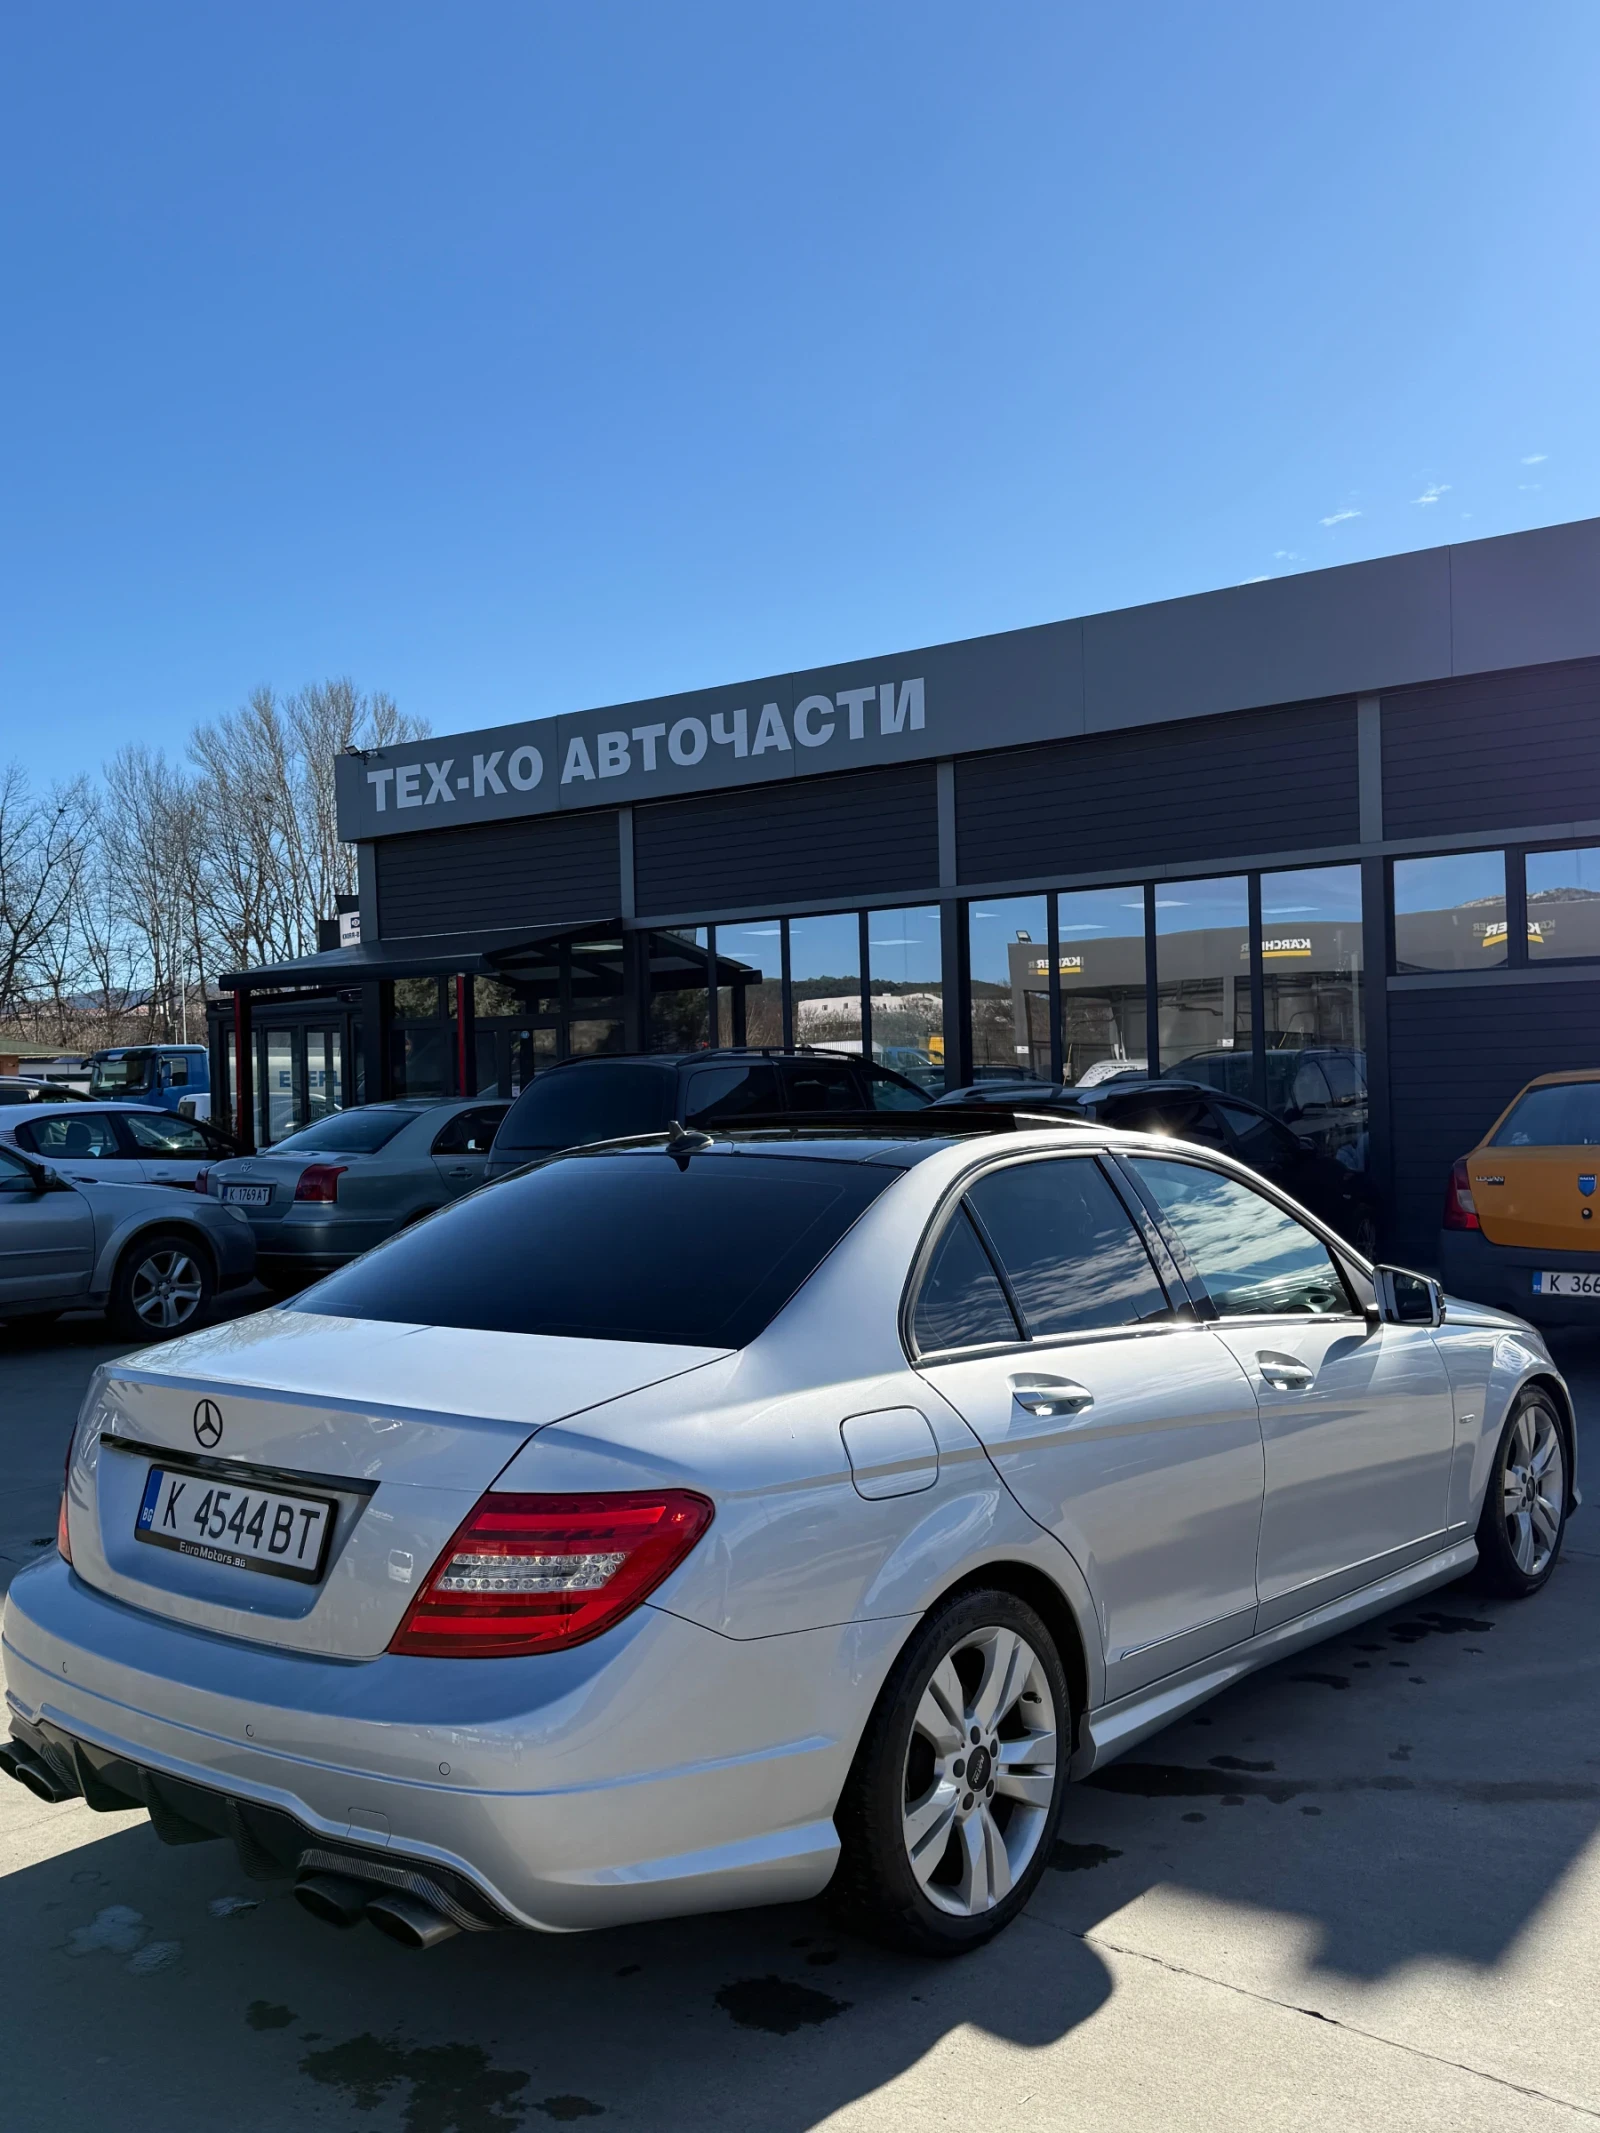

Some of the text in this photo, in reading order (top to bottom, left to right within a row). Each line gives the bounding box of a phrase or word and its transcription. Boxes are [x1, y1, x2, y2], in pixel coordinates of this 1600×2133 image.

[367, 677, 926, 812] ТЕХ-КО АВТОЧАСТИ
[230, 1188, 235, 1201] K
[1550, 1274, 1561, 1292] K
[141, 1506, 154, 1522] BG
[163, 1481, 187, 1530] K
